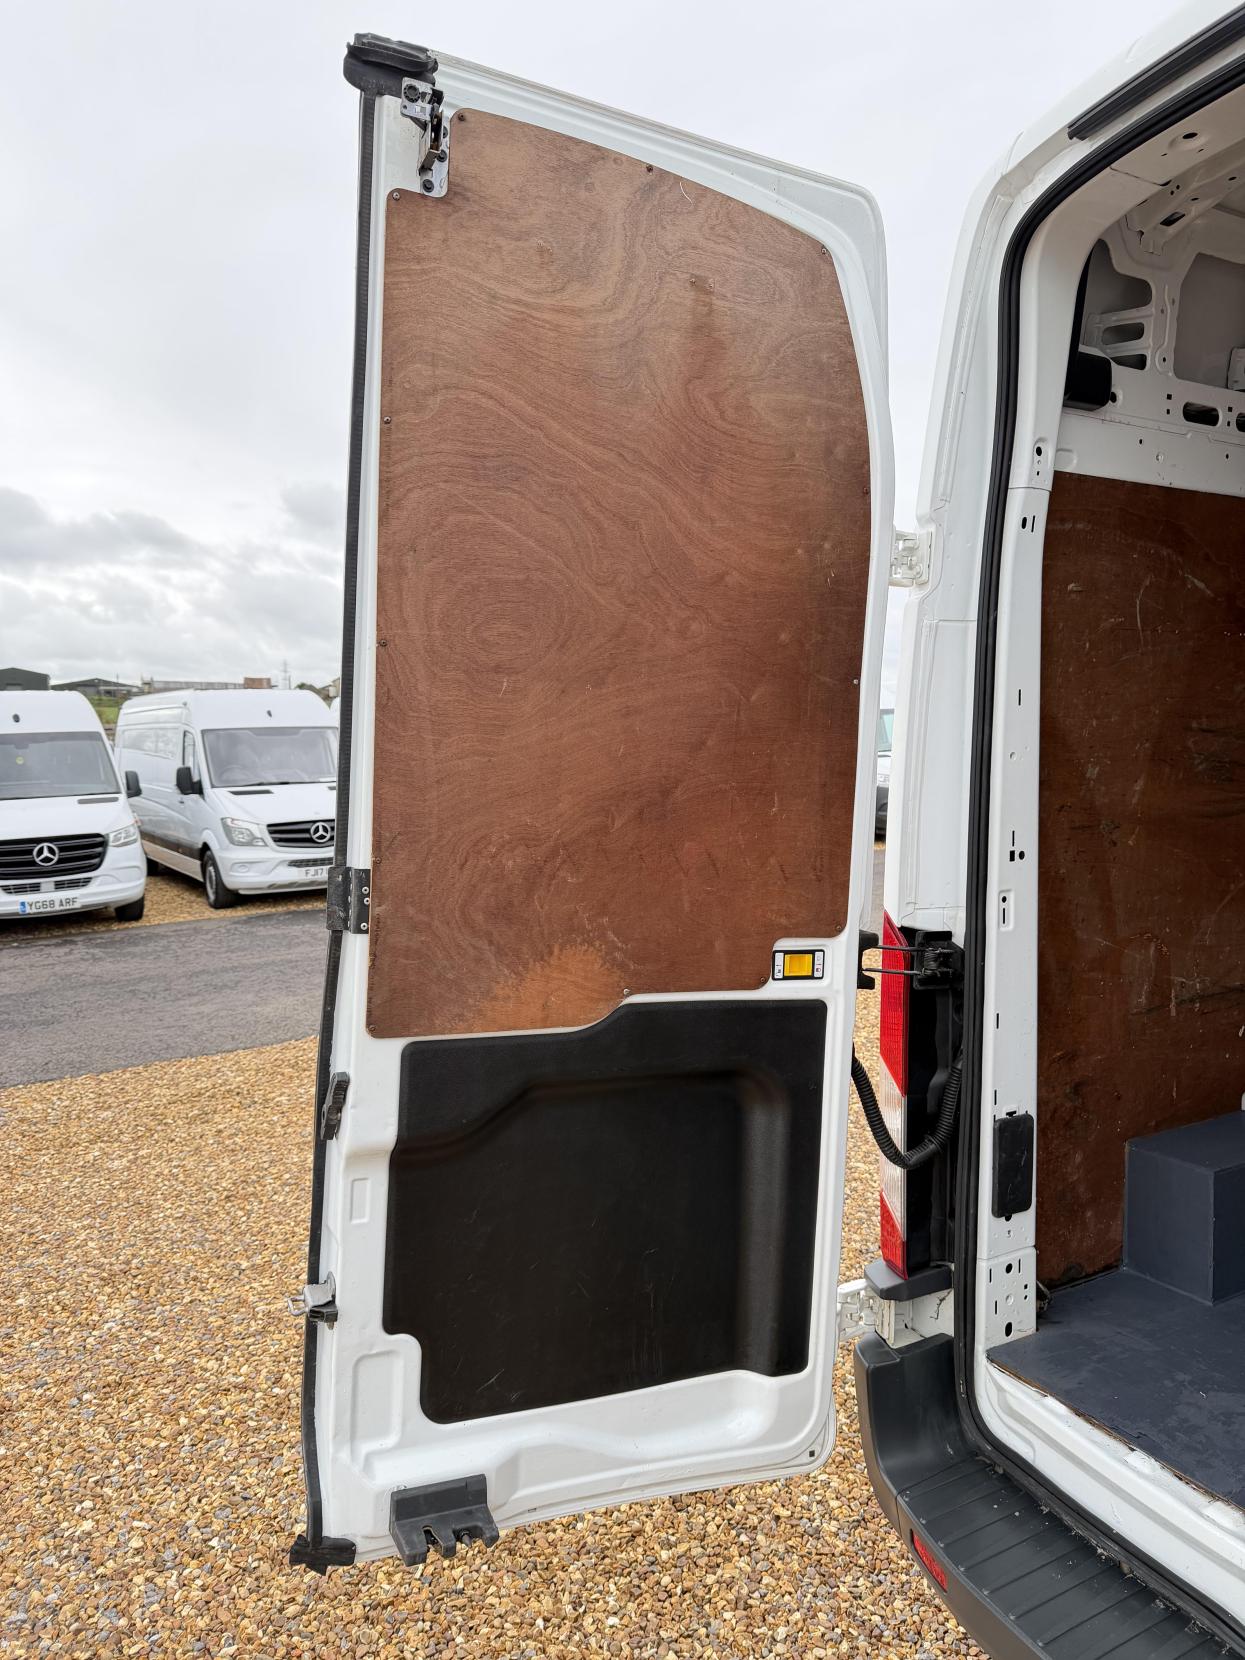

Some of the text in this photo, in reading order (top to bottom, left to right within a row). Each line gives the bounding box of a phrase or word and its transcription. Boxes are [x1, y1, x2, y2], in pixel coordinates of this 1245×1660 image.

[304, 867, 324, 877] FJ17
[27, 897, 78, 910] YG68 ARF
